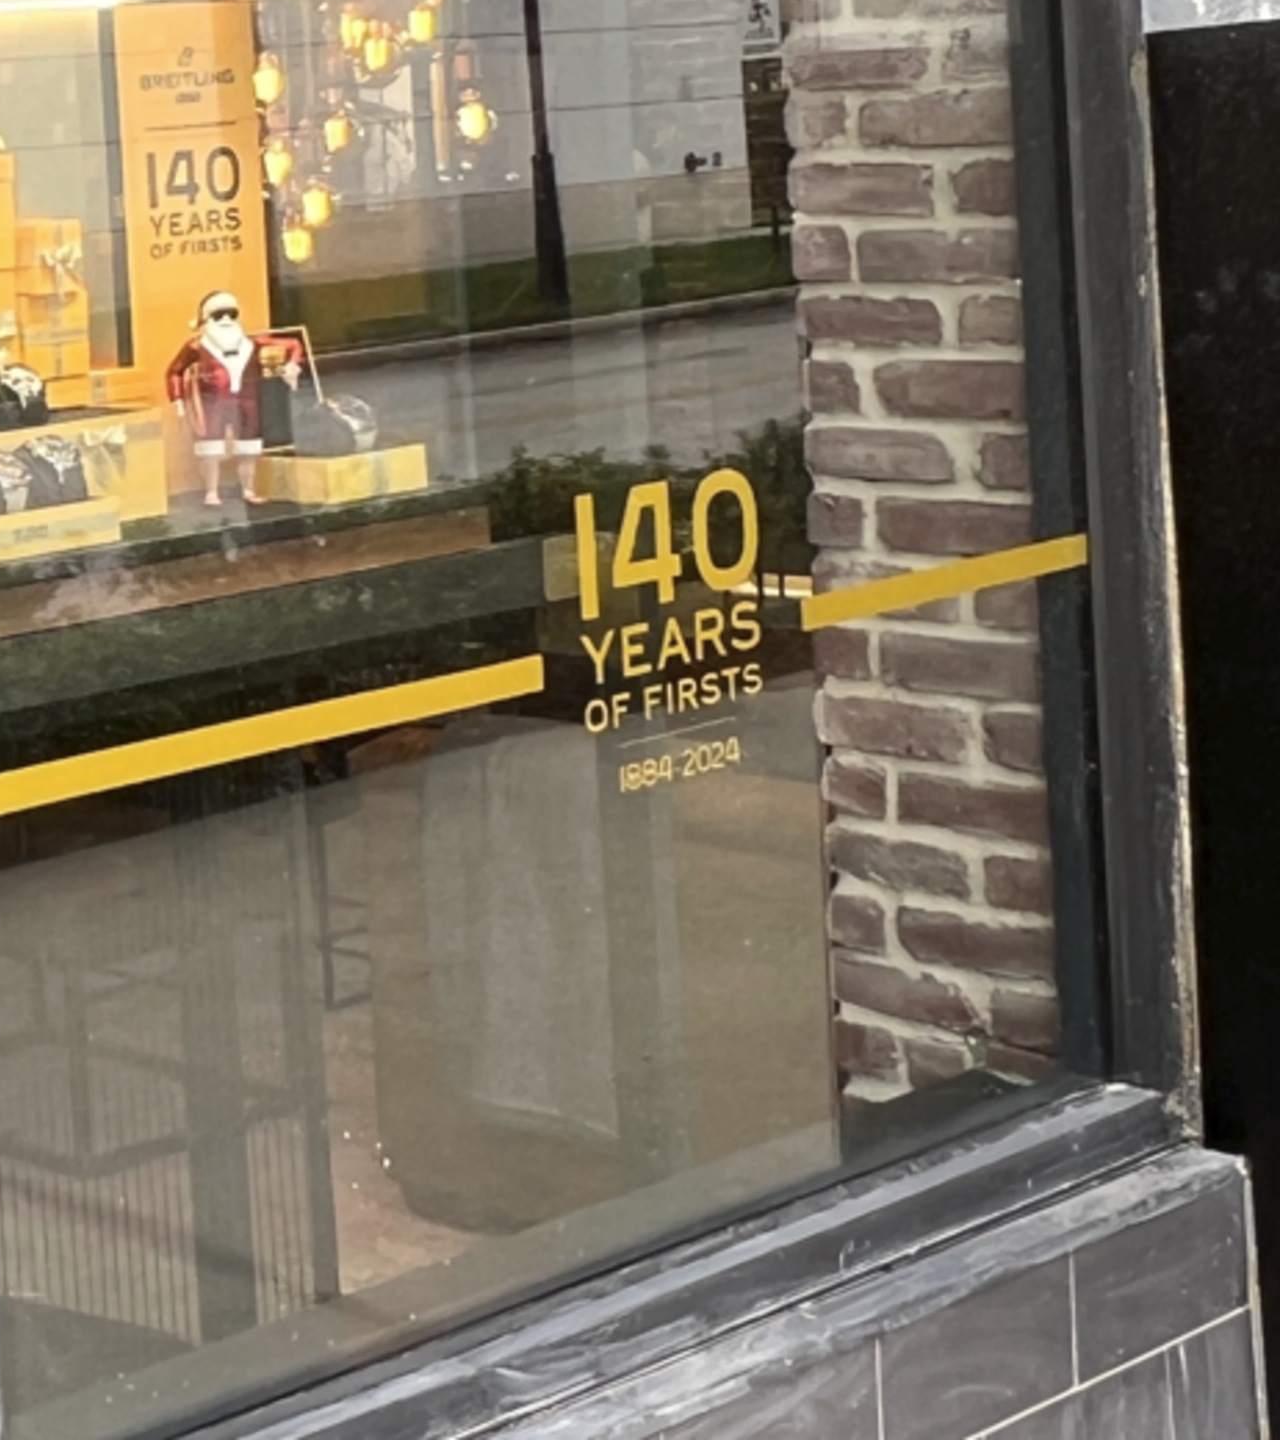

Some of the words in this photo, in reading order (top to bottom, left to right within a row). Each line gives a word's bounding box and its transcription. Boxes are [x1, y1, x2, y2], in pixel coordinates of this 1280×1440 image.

[140, 69, 235, 90] BREITLING
[146, 147, 241, 209] 140
[149, 207, 242, 238] YEARS
[150, 242, 173, 260] OF
[179, 235, 243, 255] FIRSTS
[574, 467, 759, 621] 140
[580, 601, 762, 685] YEARS
[584, 691, 631, 733] OF
[643, 663, 763, 721] FIRSTS
[620, 736, 741, 793] 1884-2024
